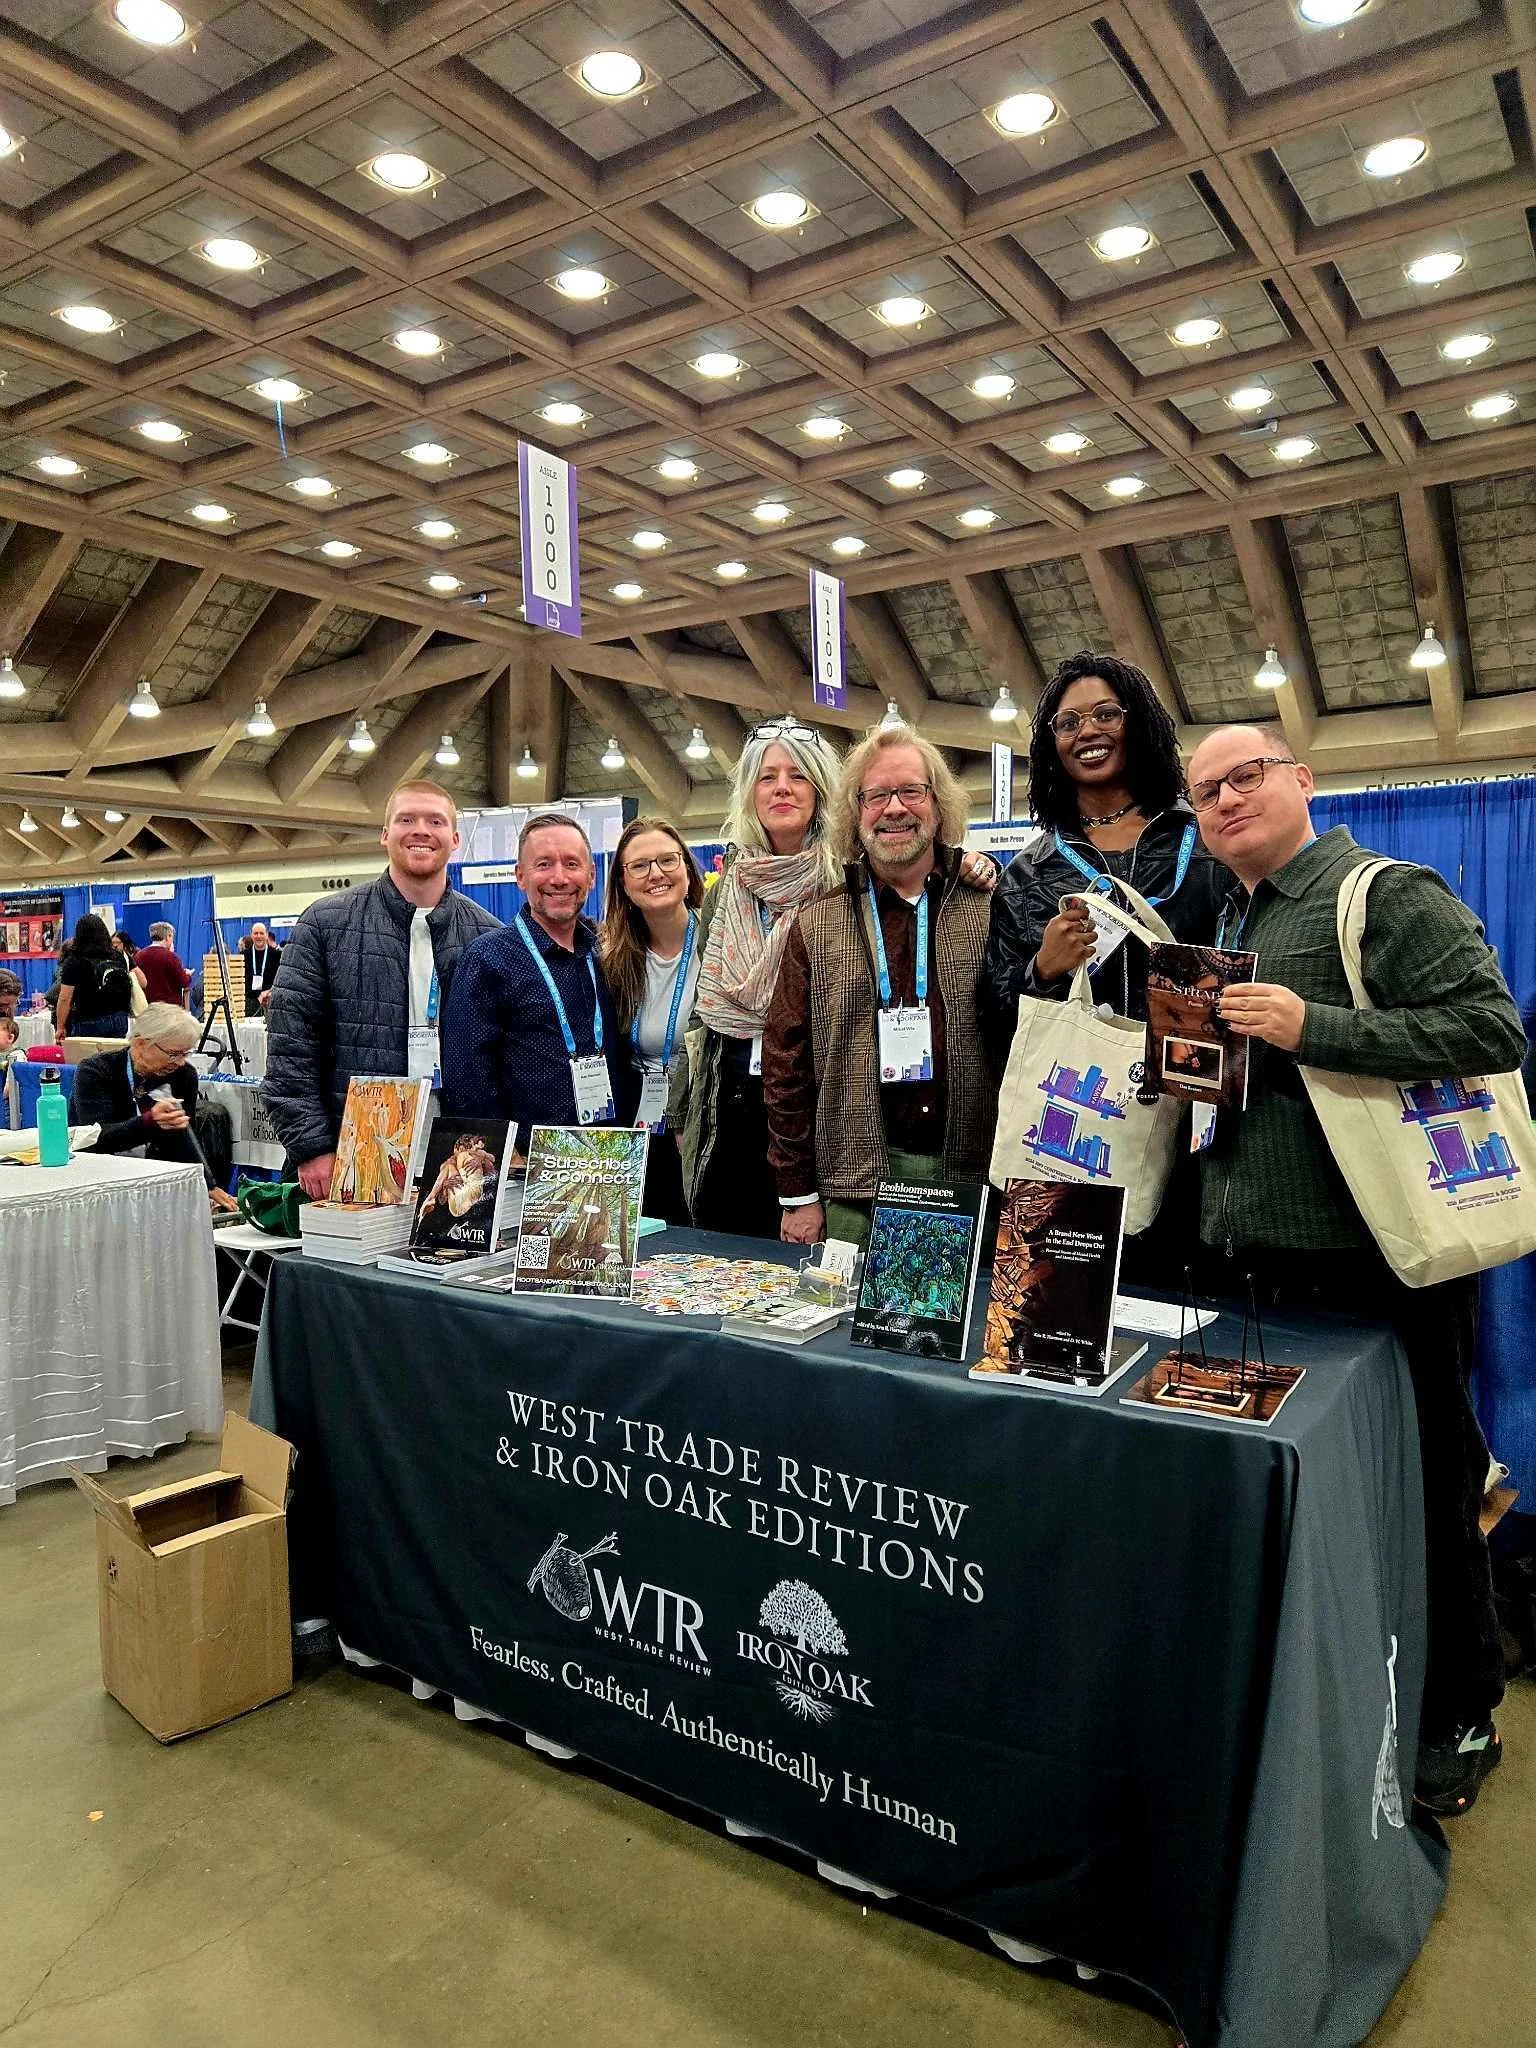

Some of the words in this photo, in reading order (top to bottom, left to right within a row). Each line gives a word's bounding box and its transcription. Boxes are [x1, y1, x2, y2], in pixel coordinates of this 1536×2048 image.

[540, 466, 558, 480] AISLE
[545, 485, 557, 590] 1000
[825, 599, 833, 677] 1100
[1063, 845, 1090, 872] PROGRAMS
[682, 919, 696, 954] ASSOCIATION
[539, 1170, 553, 1183] &
[556, 1170, 634, 1185] Connect
[544, 1157, 632, 1171] Subscribe
[879, 1181, 954, 1198] Ecobloomspaces
[461, 1229, 485, 1241] WTR
[1054, 1230, 1072, 1238] Brand
[1072, 1231, 1085, 1239] New
[1086, 1232, 1102, 1241] Word
[571, 1258, 596, 1270] WTR
[507, 1391, 604, 1445] WEST
[616, 1415, 762, 1486] TRADE
[777, 1456, 970, 1540] REVIEW
[497, 1437, 519, 1468] &
[531, 1443, 632, 1500] IRON
[645, 1474, 732, 1529] OAK
[747, 1498, 984, 1603] EDITIONS
[594, 1568, 708, 1662] WTR
[594, 1626, 623, 1643] WEST
[629, 1638, 664, 1658] TRADE
[669, 1653, 711, 1677] REVIEW
[736, 1631, 803, 1681] IRON
[808, 1662, 875, 1708] OAK
[782, 1674, 823, 1699] EDITIONS
[469, 1625, 555, 1683] Fearless.
[561, 1661, 654, 1721] Crafted.
[660, 1700, 834, 1803] Authentically
[842, 1770, 957, 1845] Human
